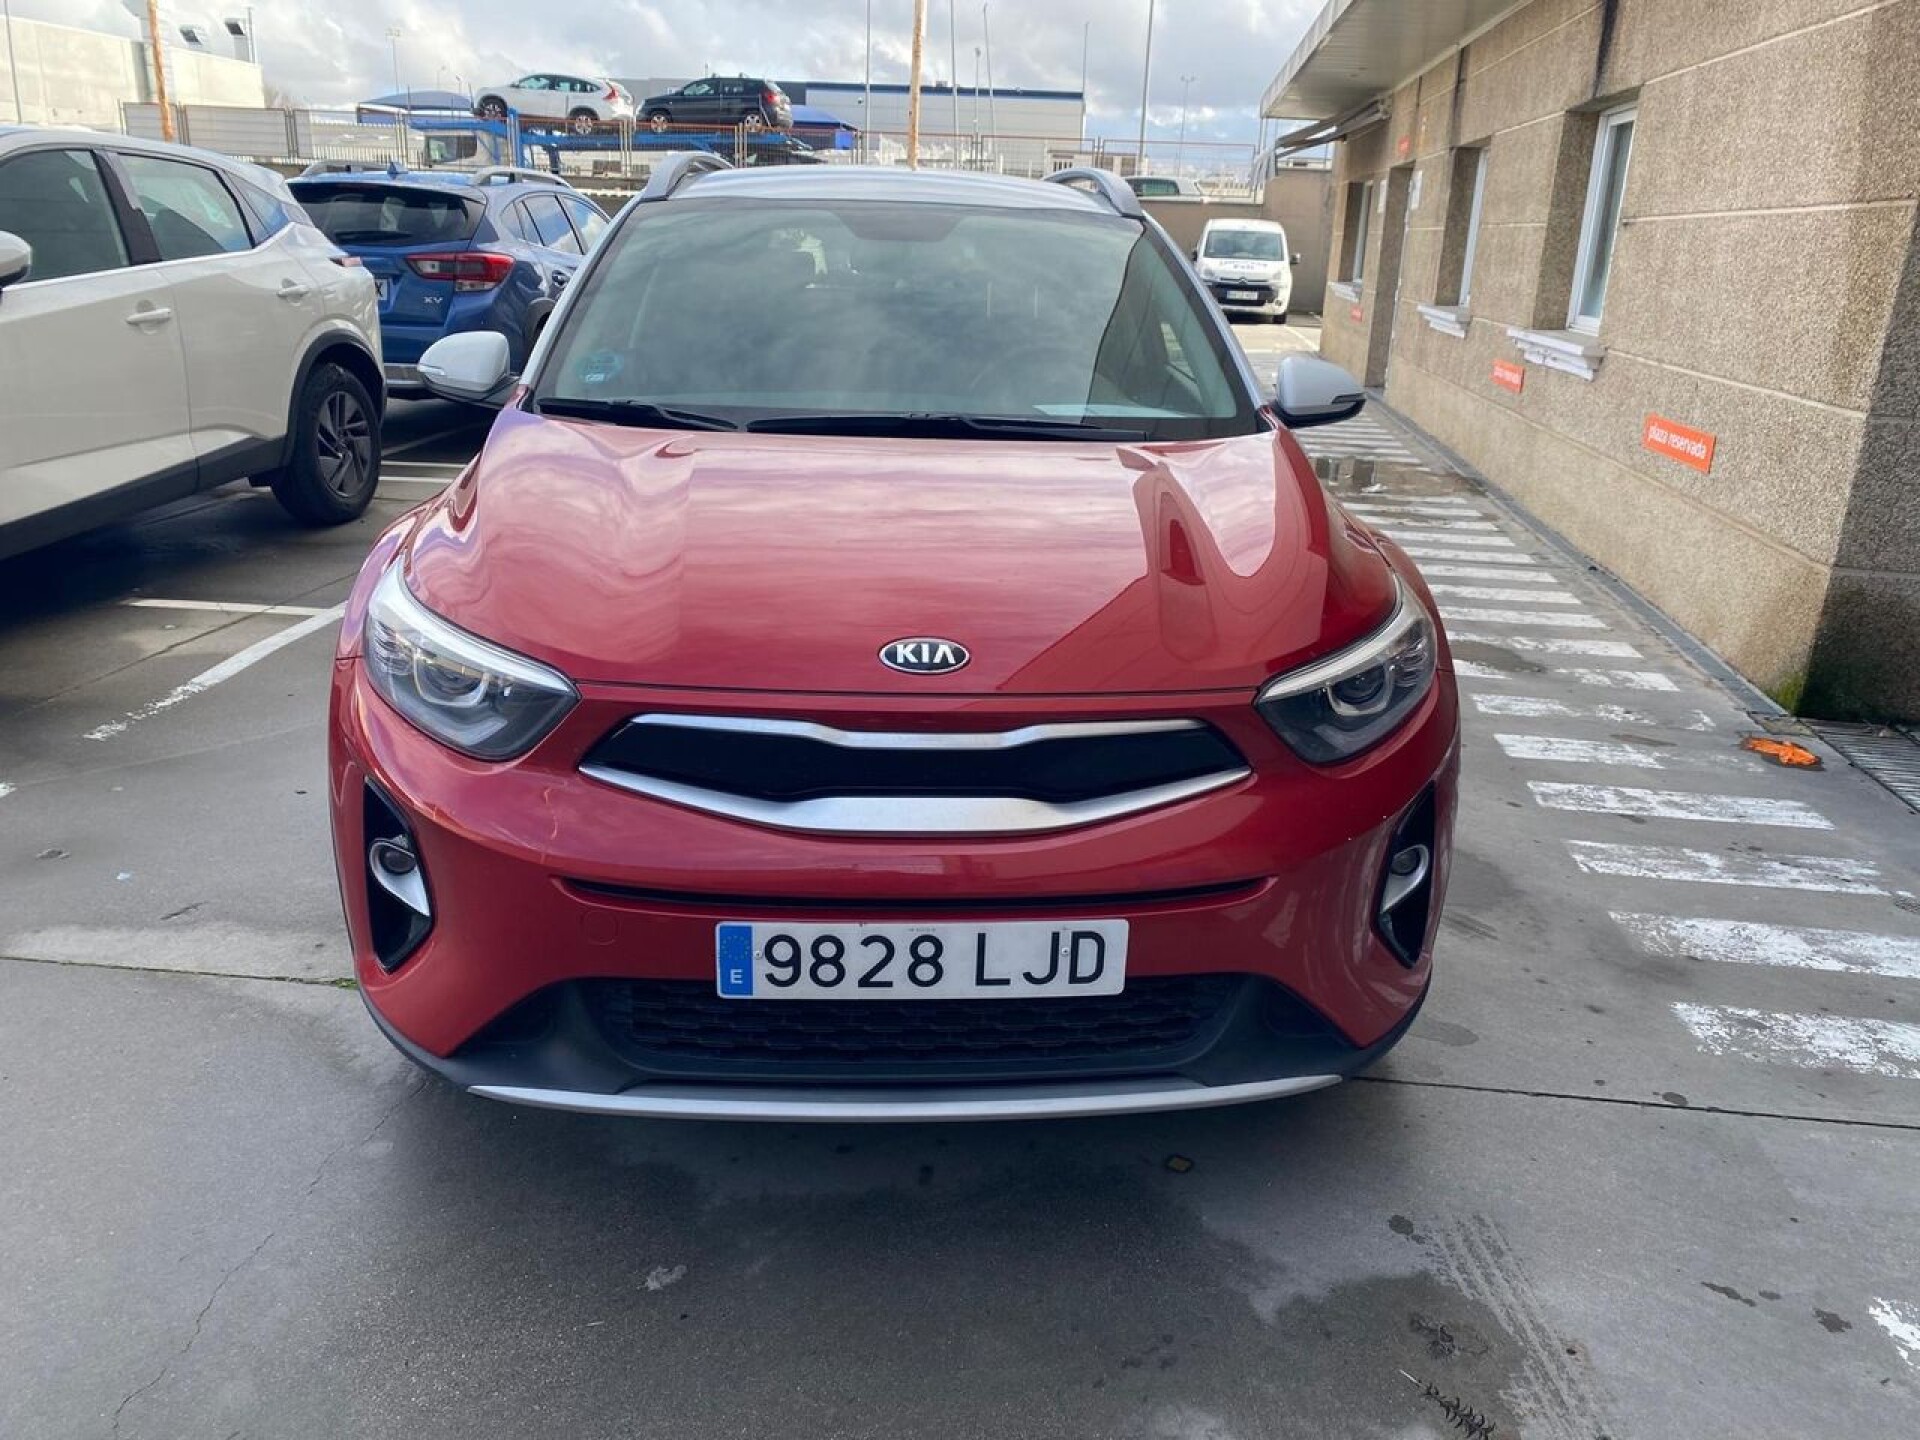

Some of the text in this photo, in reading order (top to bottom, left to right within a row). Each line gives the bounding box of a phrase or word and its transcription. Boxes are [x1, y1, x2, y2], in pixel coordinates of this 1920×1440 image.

[424, 296, 444, 304] XV
[1648, 422, 1707, 460] plaza reservada
[896, 643, 956, 664] KIA
[729, 930, 1106, 988] E 9828 LJD
